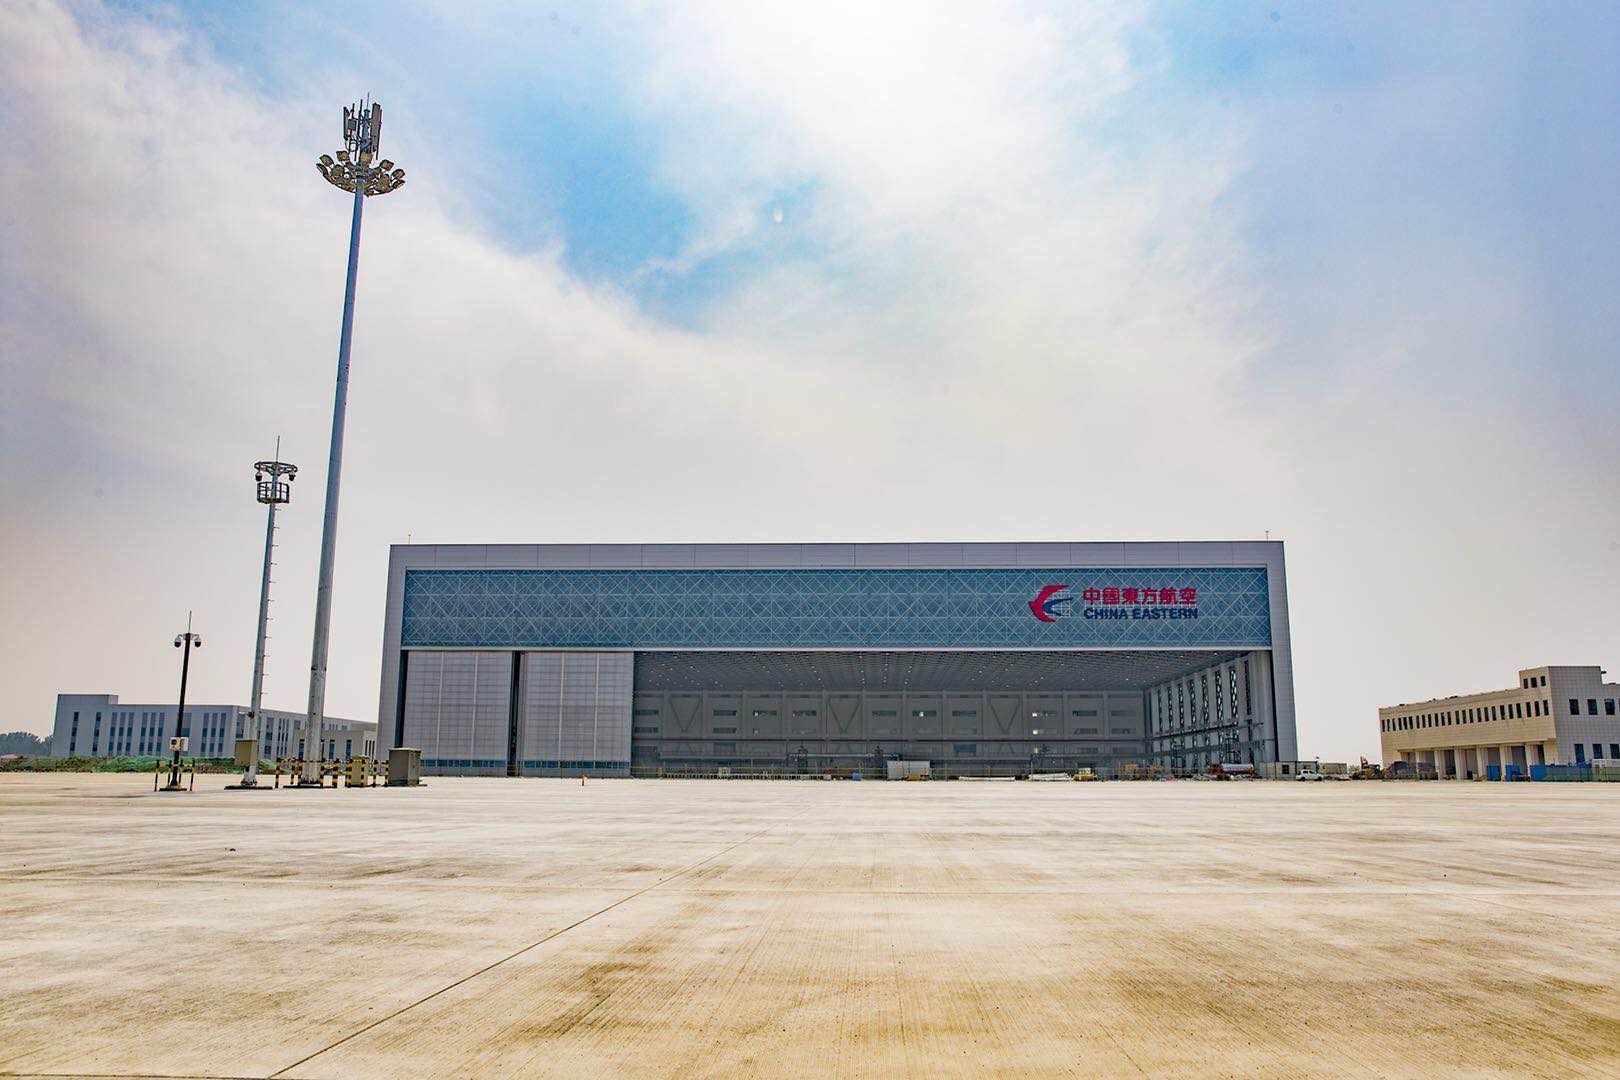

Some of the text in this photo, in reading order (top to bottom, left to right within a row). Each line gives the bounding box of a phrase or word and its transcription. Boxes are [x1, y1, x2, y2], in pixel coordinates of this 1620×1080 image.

[1083, 587, 1197, 605] 中國東方航空
[1083, 608, 1198, 620] CHINA EASTERN
